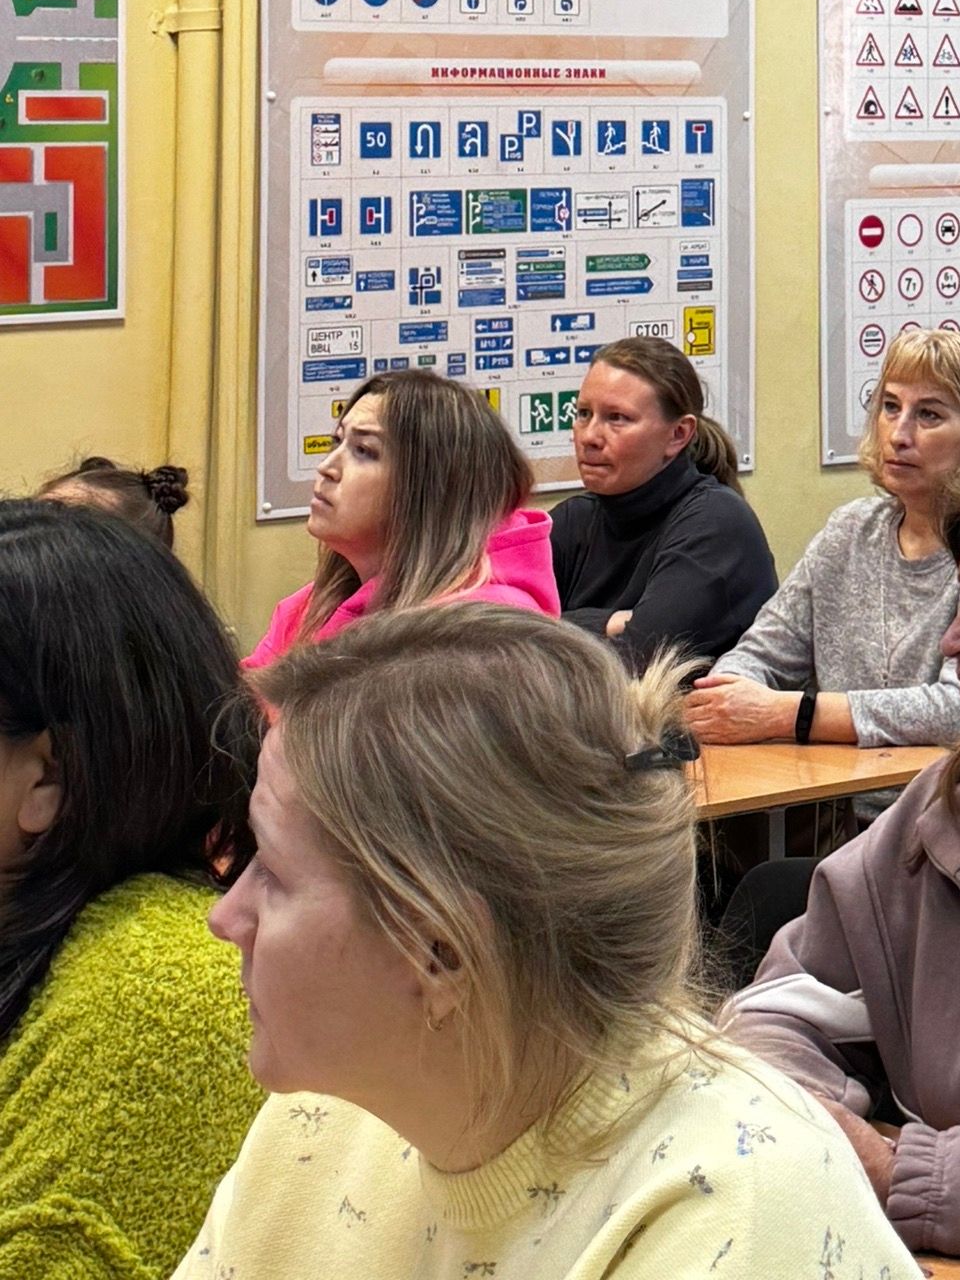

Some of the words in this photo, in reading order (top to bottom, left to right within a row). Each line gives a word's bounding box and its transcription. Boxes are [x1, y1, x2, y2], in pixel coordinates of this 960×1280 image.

[431, 67, 561, 79] ИНФОРМАЦИОННЫЕ
[565, 68, 606, 78] ЗНАКИ
[366, 132, 386, 147] 50
[311, 331, 343, 342] ЦЕНТР
[351, 330, 359, 339] 11
[636, 323, 668, 337] СТОП
[349, 341, 359, 351] 15
